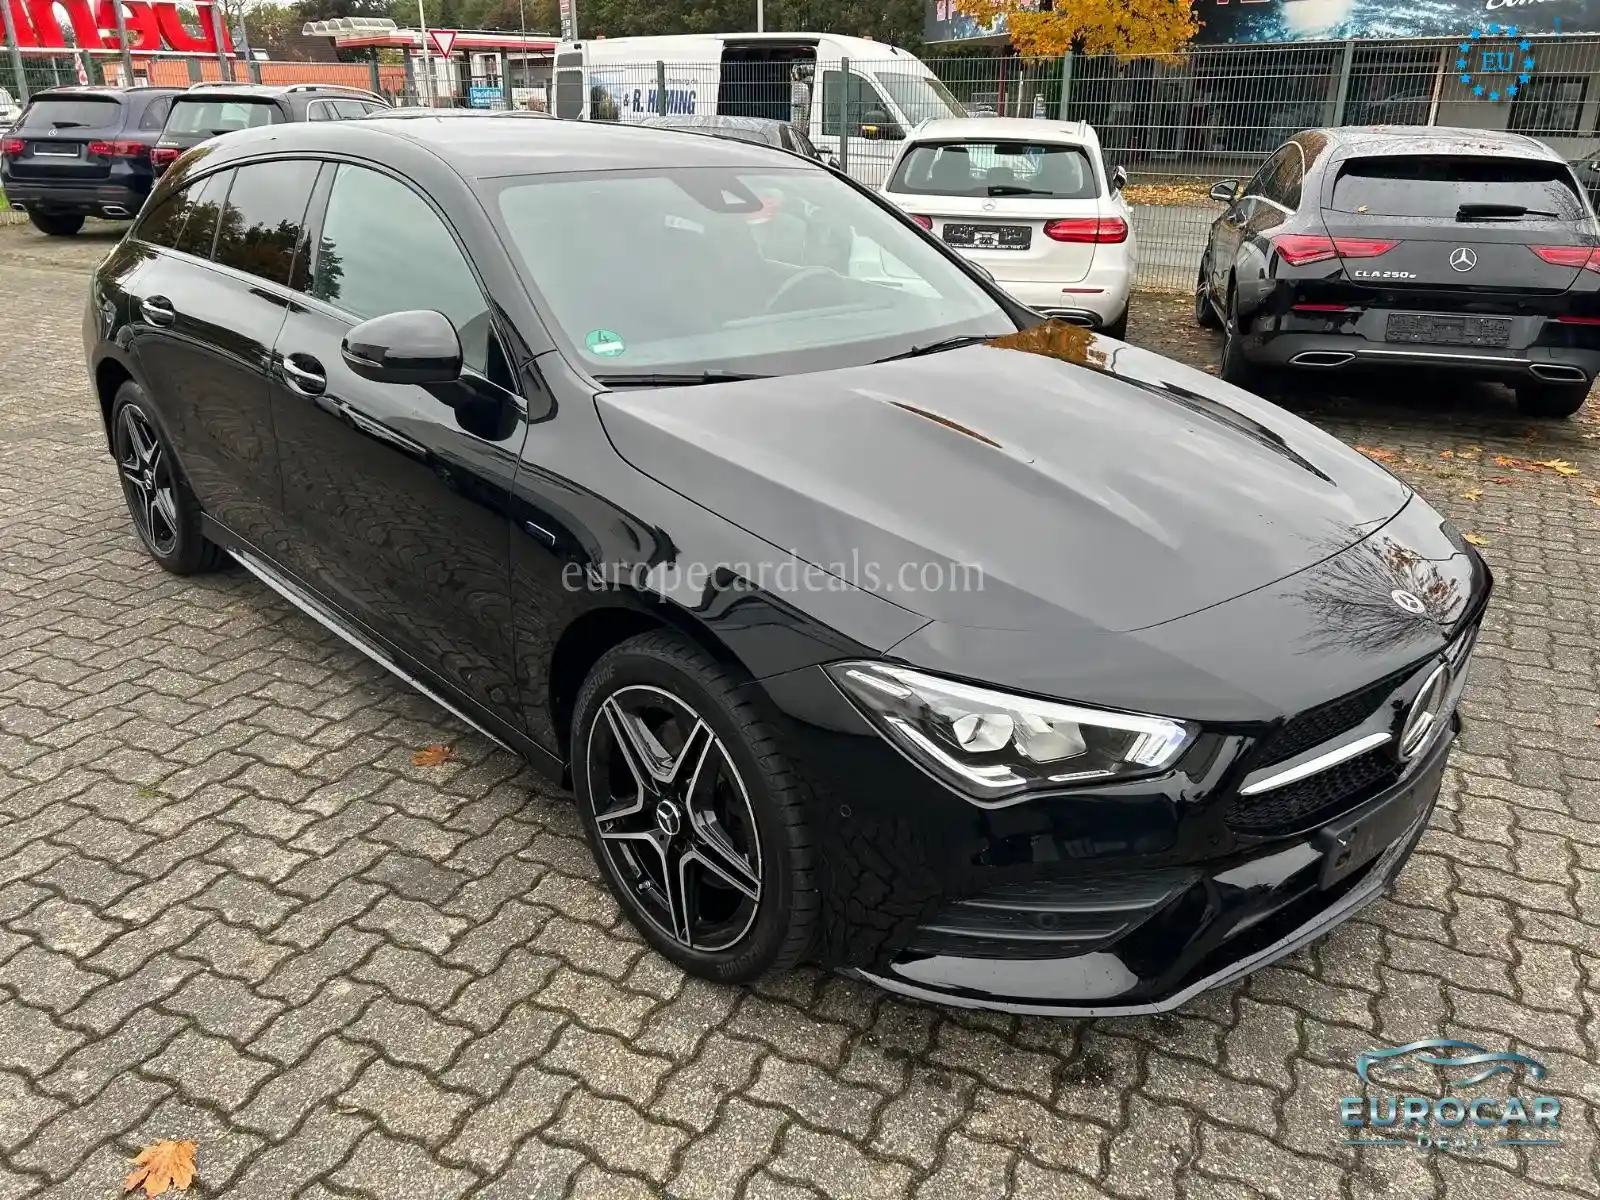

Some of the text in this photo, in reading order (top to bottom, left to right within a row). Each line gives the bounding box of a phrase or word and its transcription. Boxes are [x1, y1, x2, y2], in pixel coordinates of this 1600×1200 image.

[623, 93, 629, 106] &
[633, 89, 643, 112] R.
[1354, 270, 1417, 279] CLA 250e
